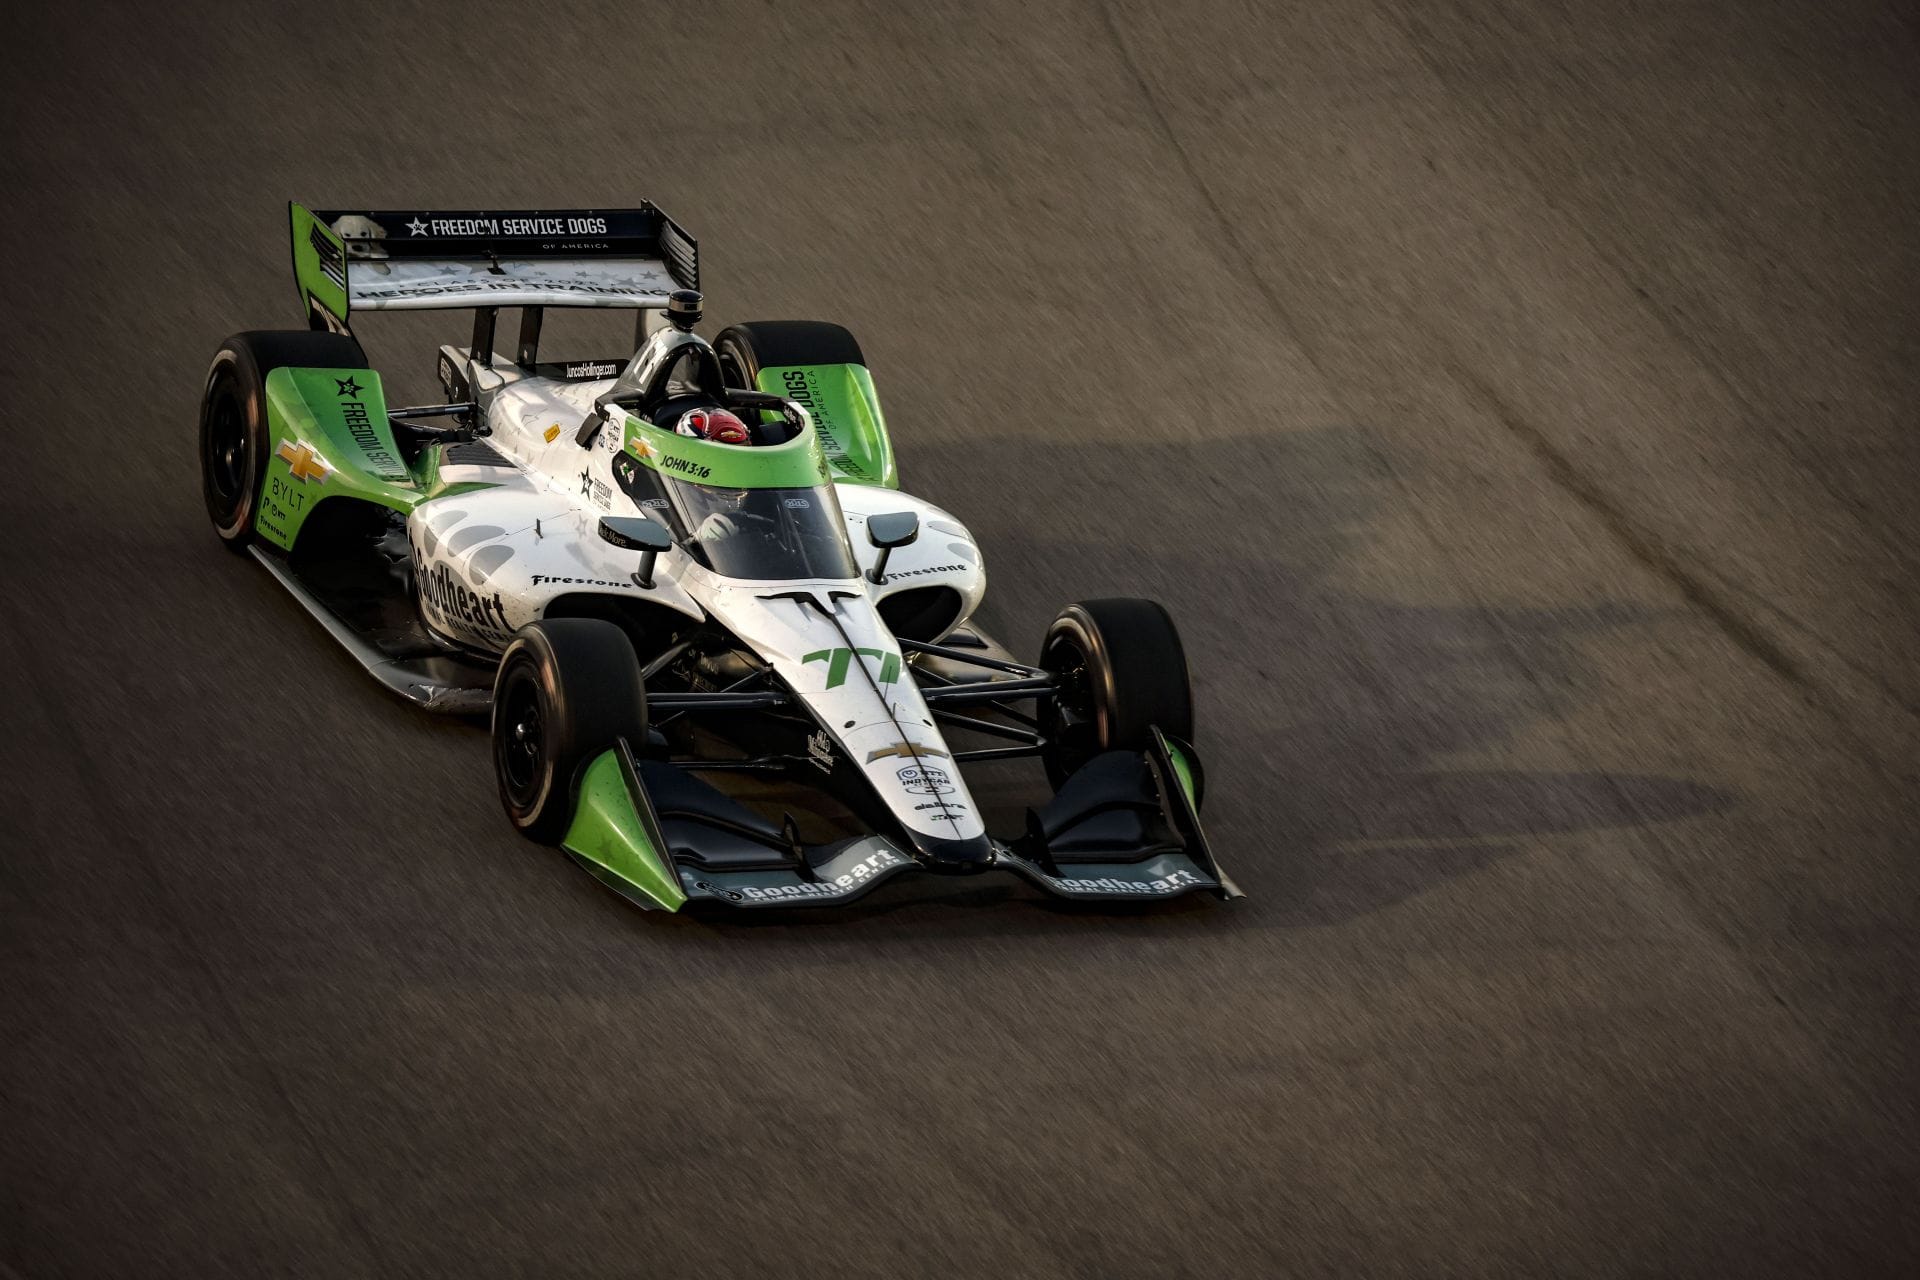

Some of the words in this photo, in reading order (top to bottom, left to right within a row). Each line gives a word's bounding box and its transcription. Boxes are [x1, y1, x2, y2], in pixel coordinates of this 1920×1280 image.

[431, 219, 500, 236] FREEDOM
[502, 218, 566, 235] SERVICE
[567, 217, 607, 234] DOGS
[356, 284, 482, 299] HEROES
[525, 283, 670, 296] TRAINING
[566, 361, 617, 380] JuncosHollinger.com
[782, 370, 815, 409] DOGS
[807, 370, 829, 416] AMERICA
[341, 402, 378, 452] FREEDOM
[660, 455, 689, 472] JOHN
[687, 462, 712, 479] 3:16
[272, 477, 305, 512] BYLT
[530, 574, 633, 588] Firestone
[886, 563, 967, 580] Firestone
[742, 848, 897, 899] Goodheart
